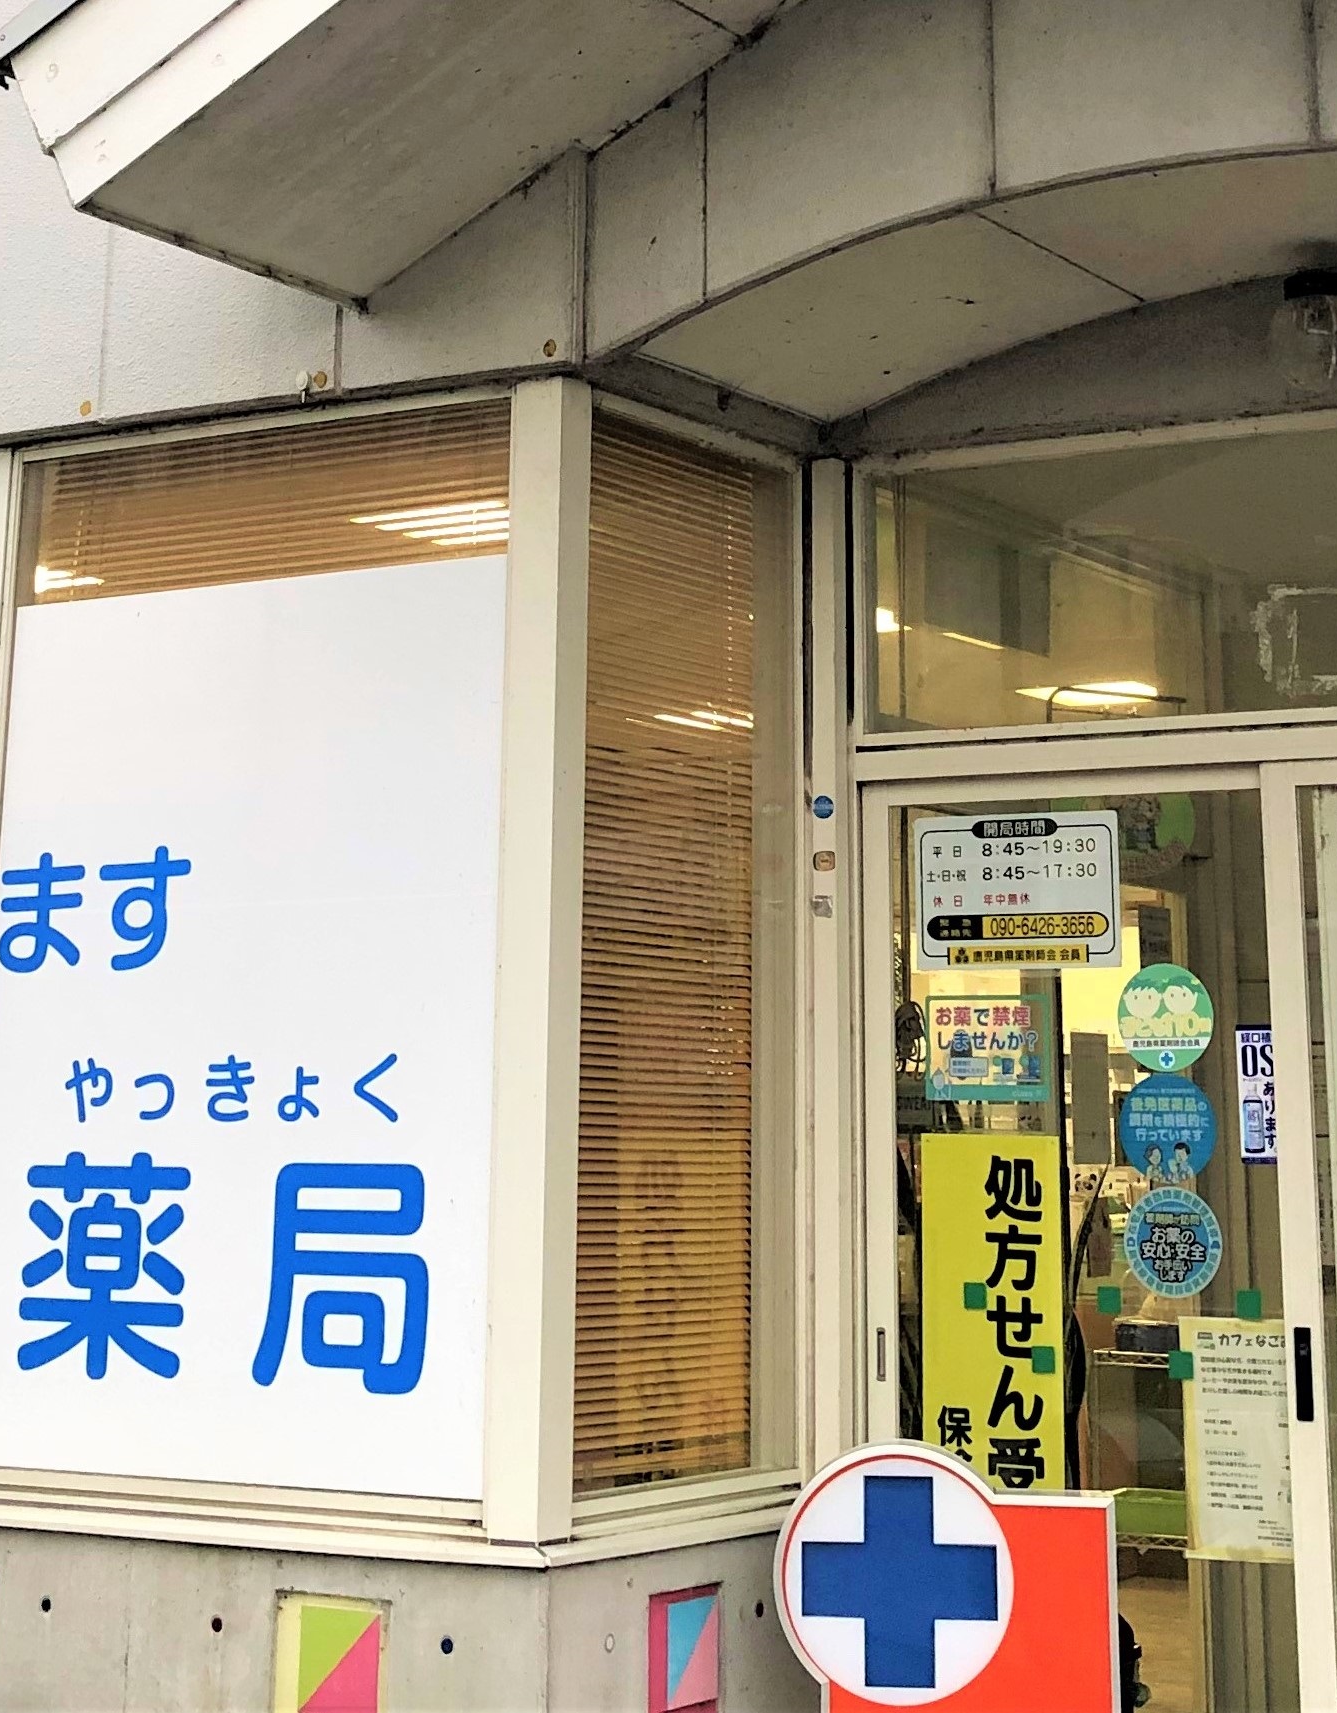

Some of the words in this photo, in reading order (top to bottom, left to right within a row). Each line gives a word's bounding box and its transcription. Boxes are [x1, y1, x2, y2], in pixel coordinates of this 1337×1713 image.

[983, 820, 1046, 837] 開局時間
[990, 916, 1095, 937] 090-6426-3656
[935, 1006, 1031, 1027] お薬で禁煙
[65, 1053, 398, 1122] やっきょく
[1152, 1227, 1194, 1243] お薬の
[938, 1405, 972, 1462] 保
